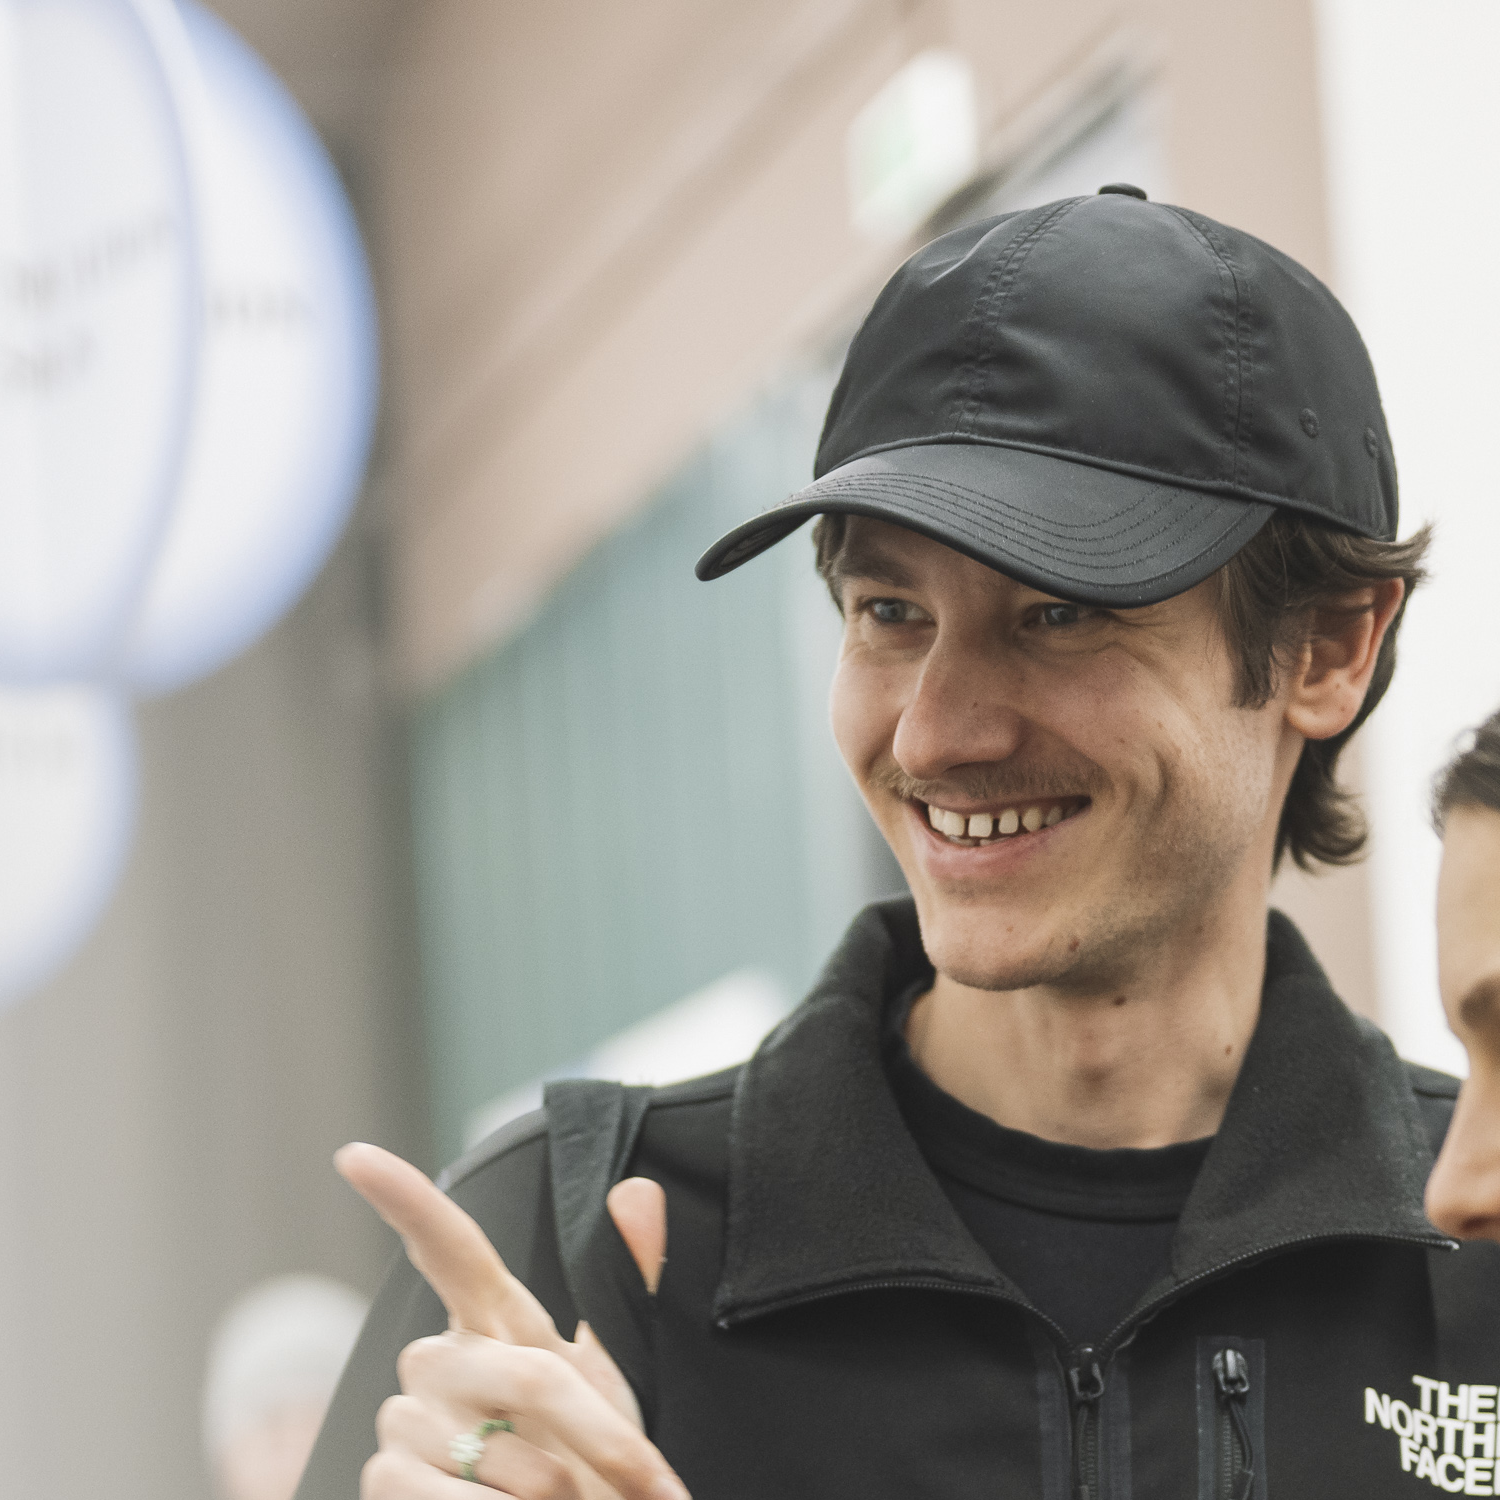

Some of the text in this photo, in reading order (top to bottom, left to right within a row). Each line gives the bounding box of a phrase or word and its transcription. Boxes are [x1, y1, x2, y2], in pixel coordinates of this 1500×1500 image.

[1364, 1386, 1496, 1459] NORTH
[1412, 1374, 1498, 1423] THE
[1399, 1436, 1495, 1496] FACE
